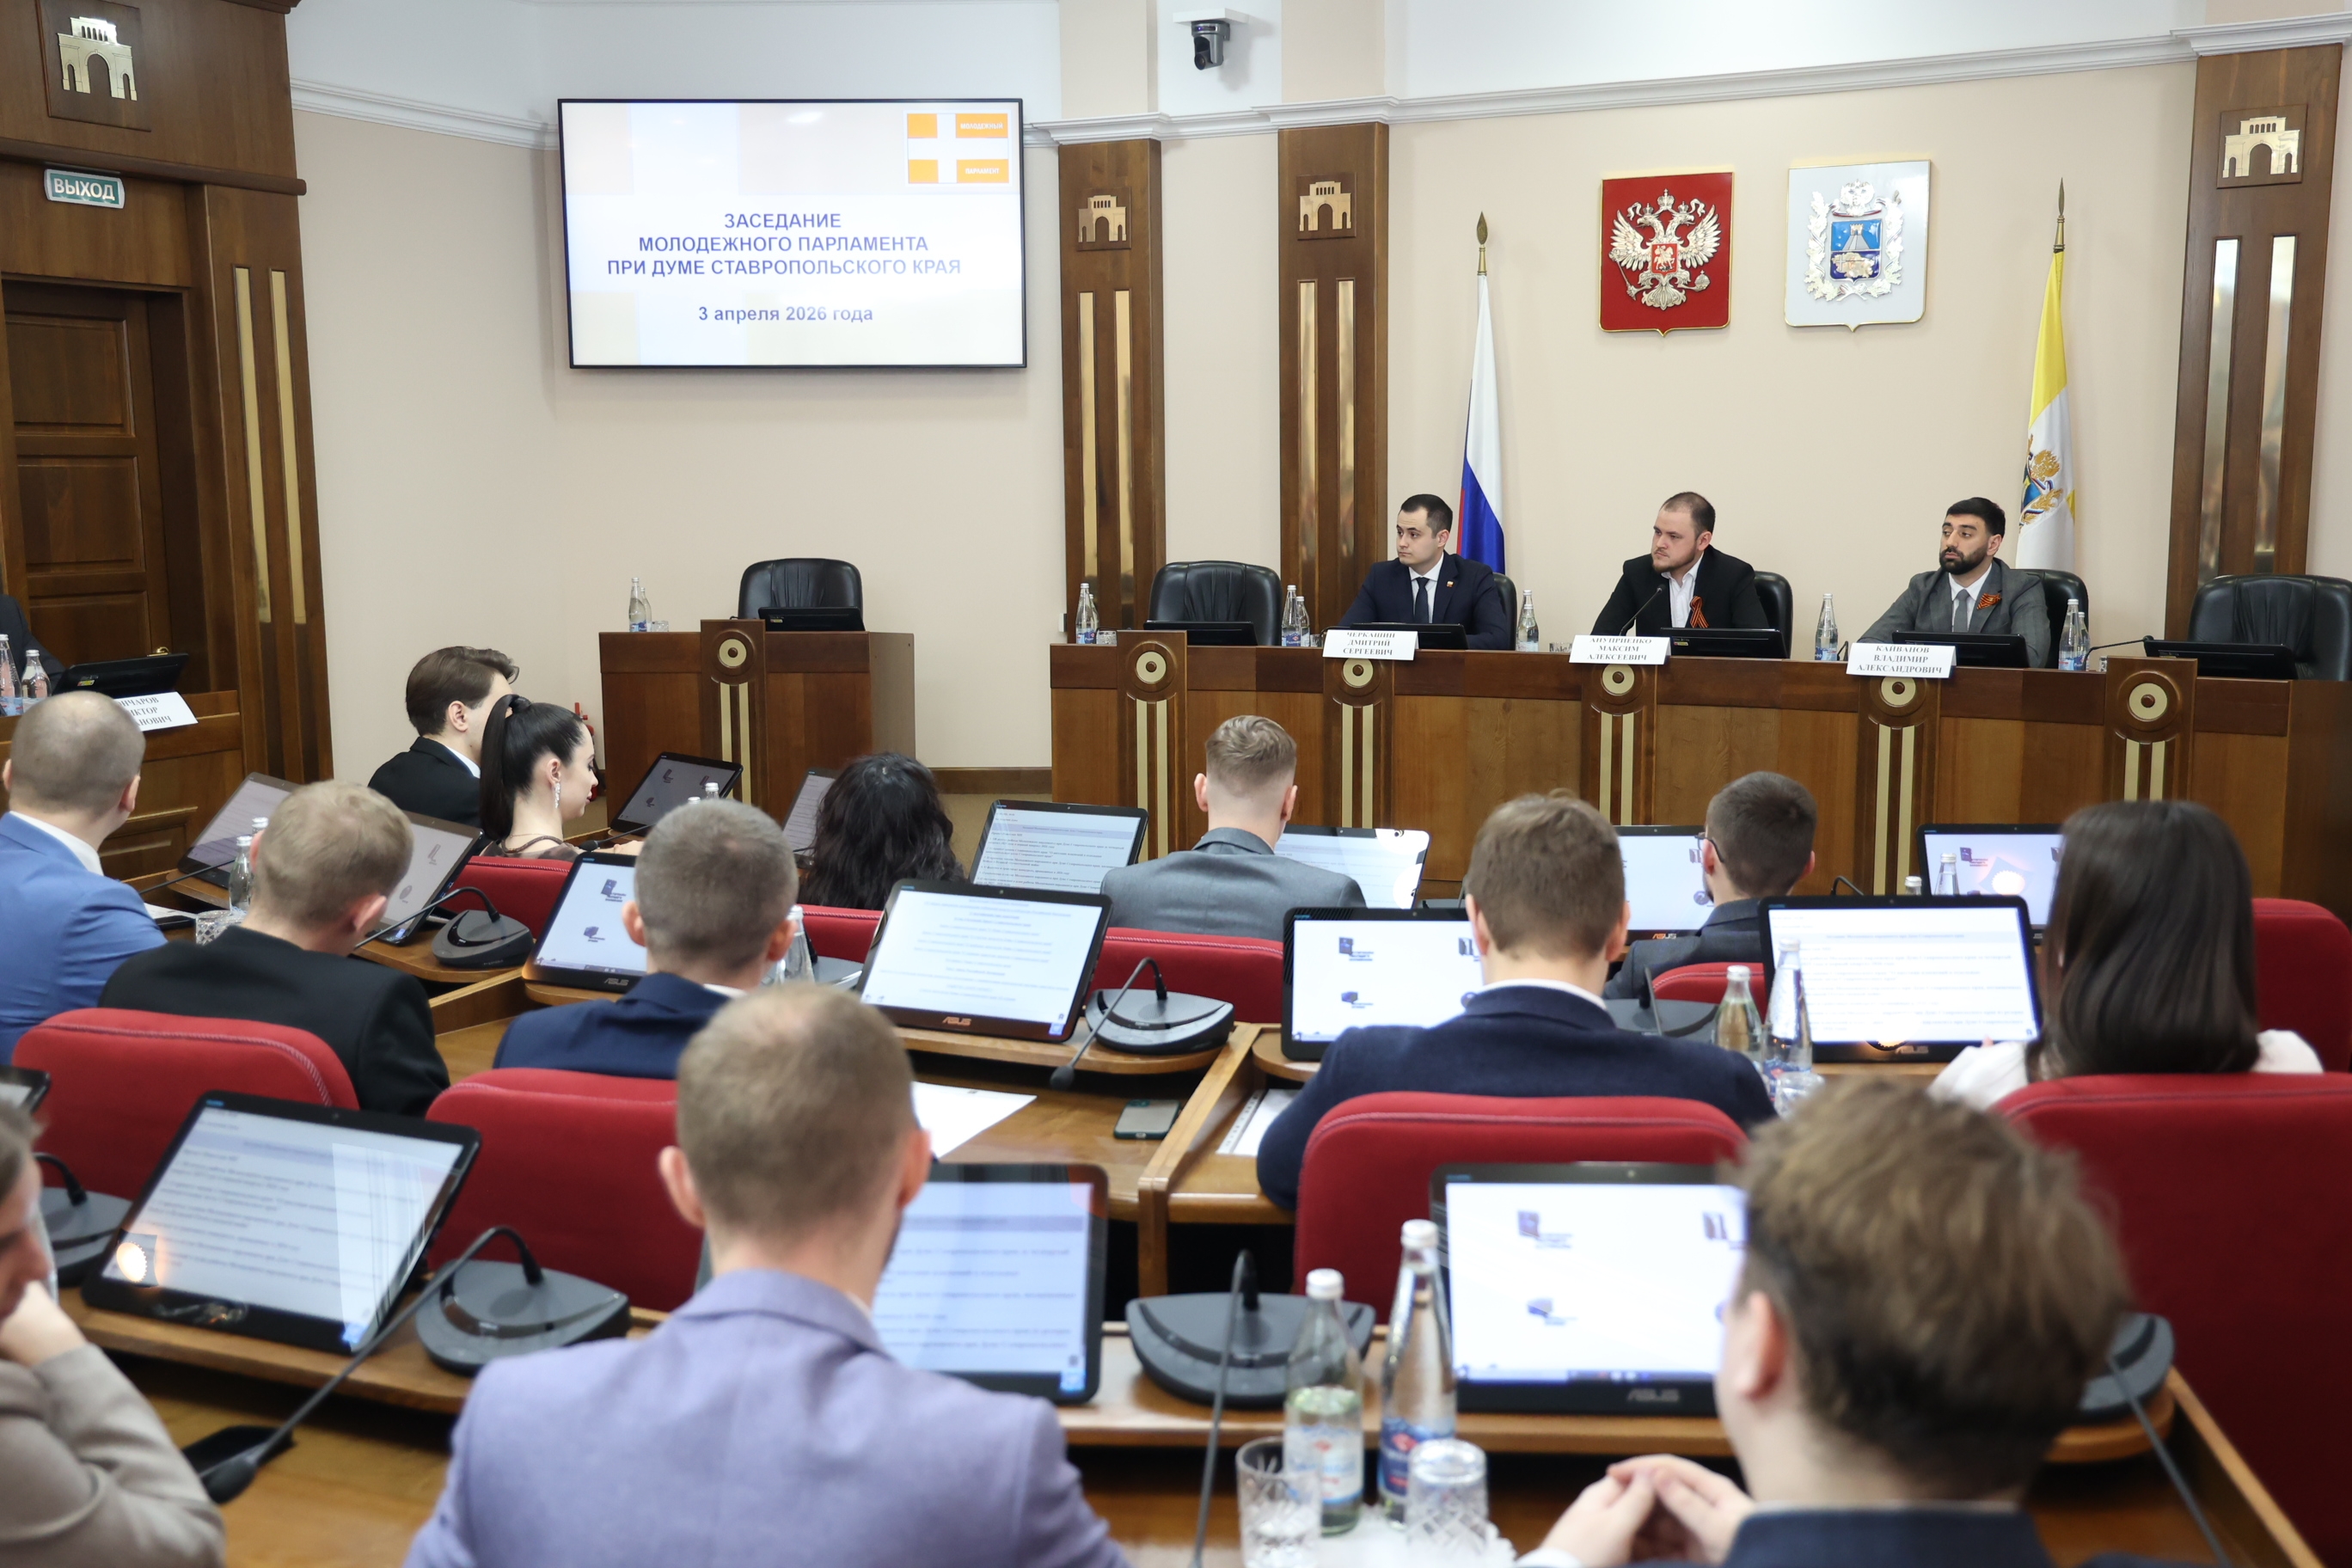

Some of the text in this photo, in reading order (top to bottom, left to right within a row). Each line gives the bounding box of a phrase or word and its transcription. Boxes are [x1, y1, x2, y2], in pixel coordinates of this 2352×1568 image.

[53, 178, 115, 200] ВЫХОД
[724, 212, 842, 231] ЗАСЕДАНИЕ
[639, 236, 928, 254] МОЛОДЕЖНОГО ПАРЛАМЕНТА
[607, 259, 962, 278] ПРИ ДУМЕ СТАВРОПОЛЬСКОГО КРАЯ
[698, 306, 873, 325] 3 апреля 2026 года
[1343, 647, 1393, 656] СЕРГЕЕВИЧ
[1876, 645, 1930, 653] КАЙВАНОВ
[1873, 654, 1929, 664] ВЛАДИМИР
[1857, 665, 1942, 674] АЛЕКСАНДРОВИЧ
[604, 977, 630, 986] ASUS
[942, 1016, 972, 1026] ASUS
